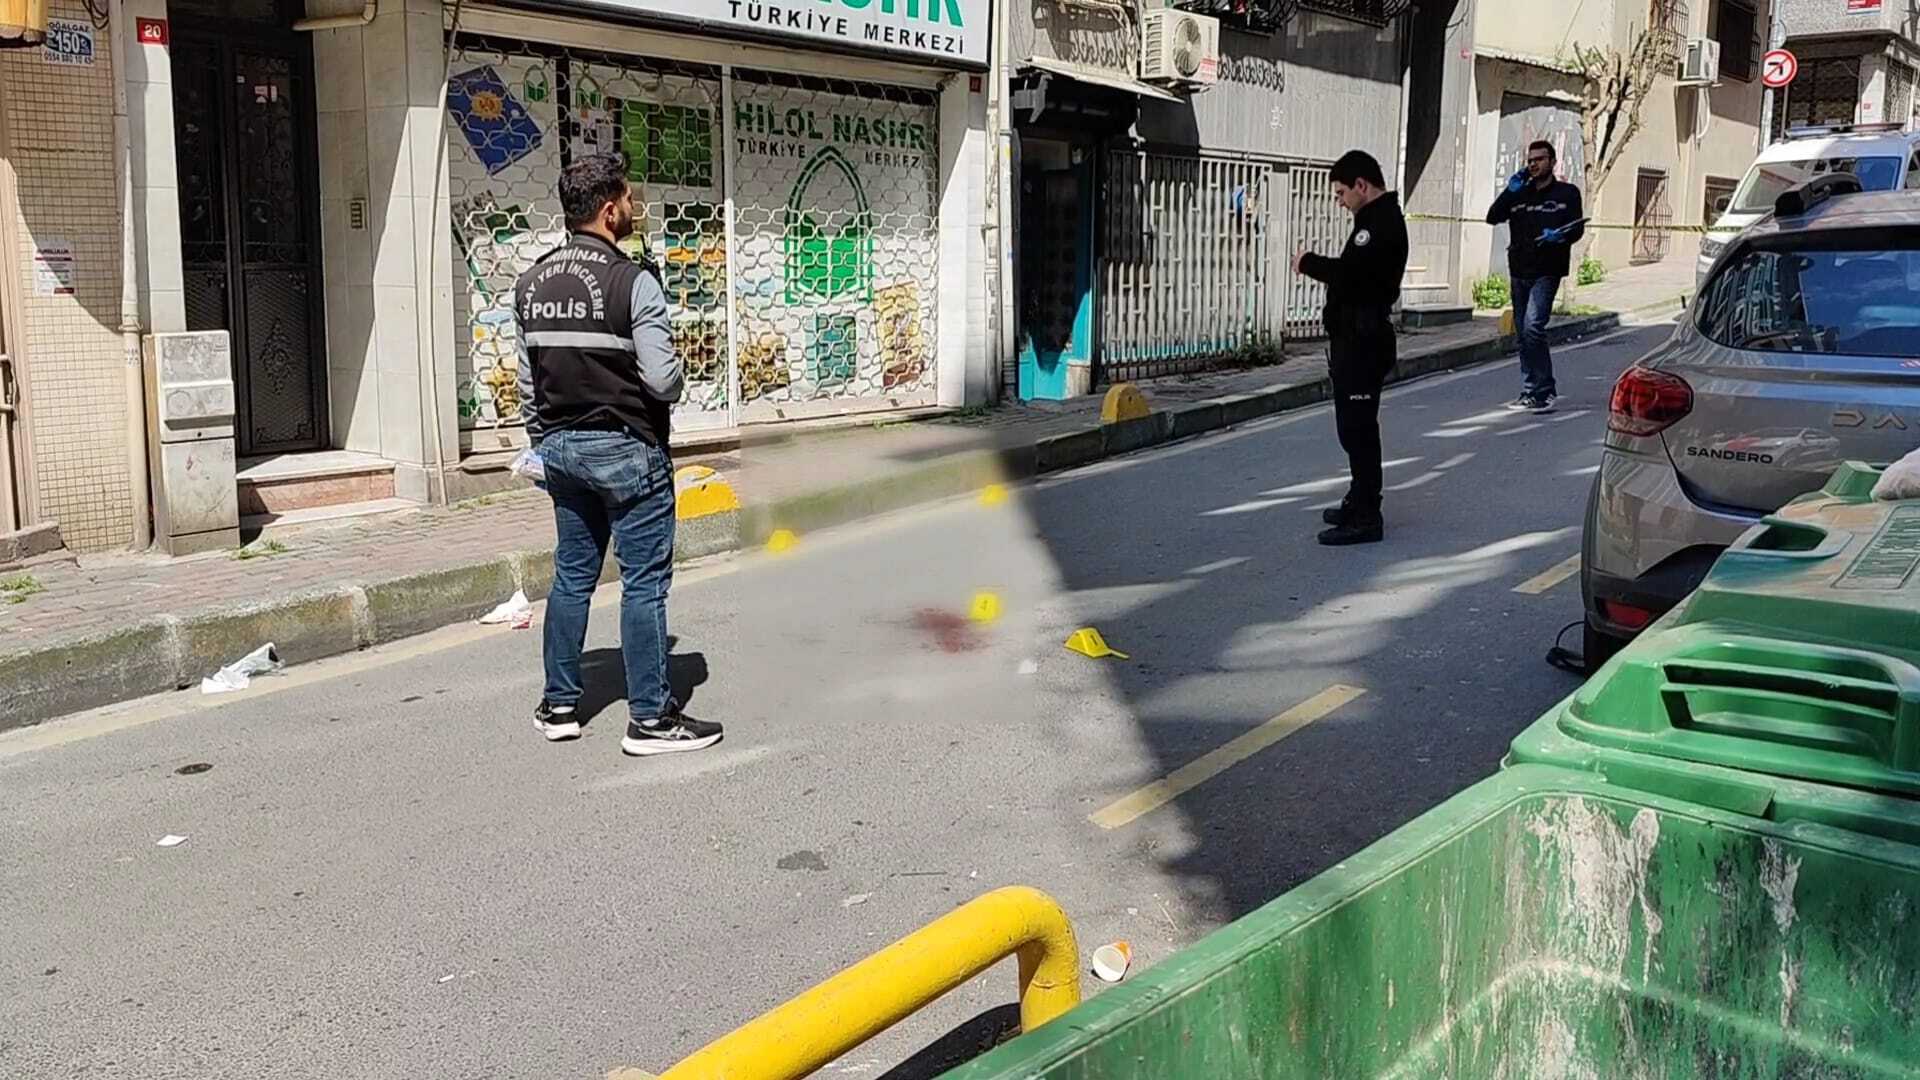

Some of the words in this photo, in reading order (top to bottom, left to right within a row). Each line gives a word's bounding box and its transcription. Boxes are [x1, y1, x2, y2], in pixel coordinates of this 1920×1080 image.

[48, 21, 89, 32] OĞALGAZ
[144, 24, 161, 38] 20
[728, 0, 847, 36] TÜRKİYE
[864, 23, 964, 54] MERKEZİ
[56, 31, 80, 53] 150
[532, 297, 587, 319] POLİS
[1687, 446, 1773, 464] SANDERO
